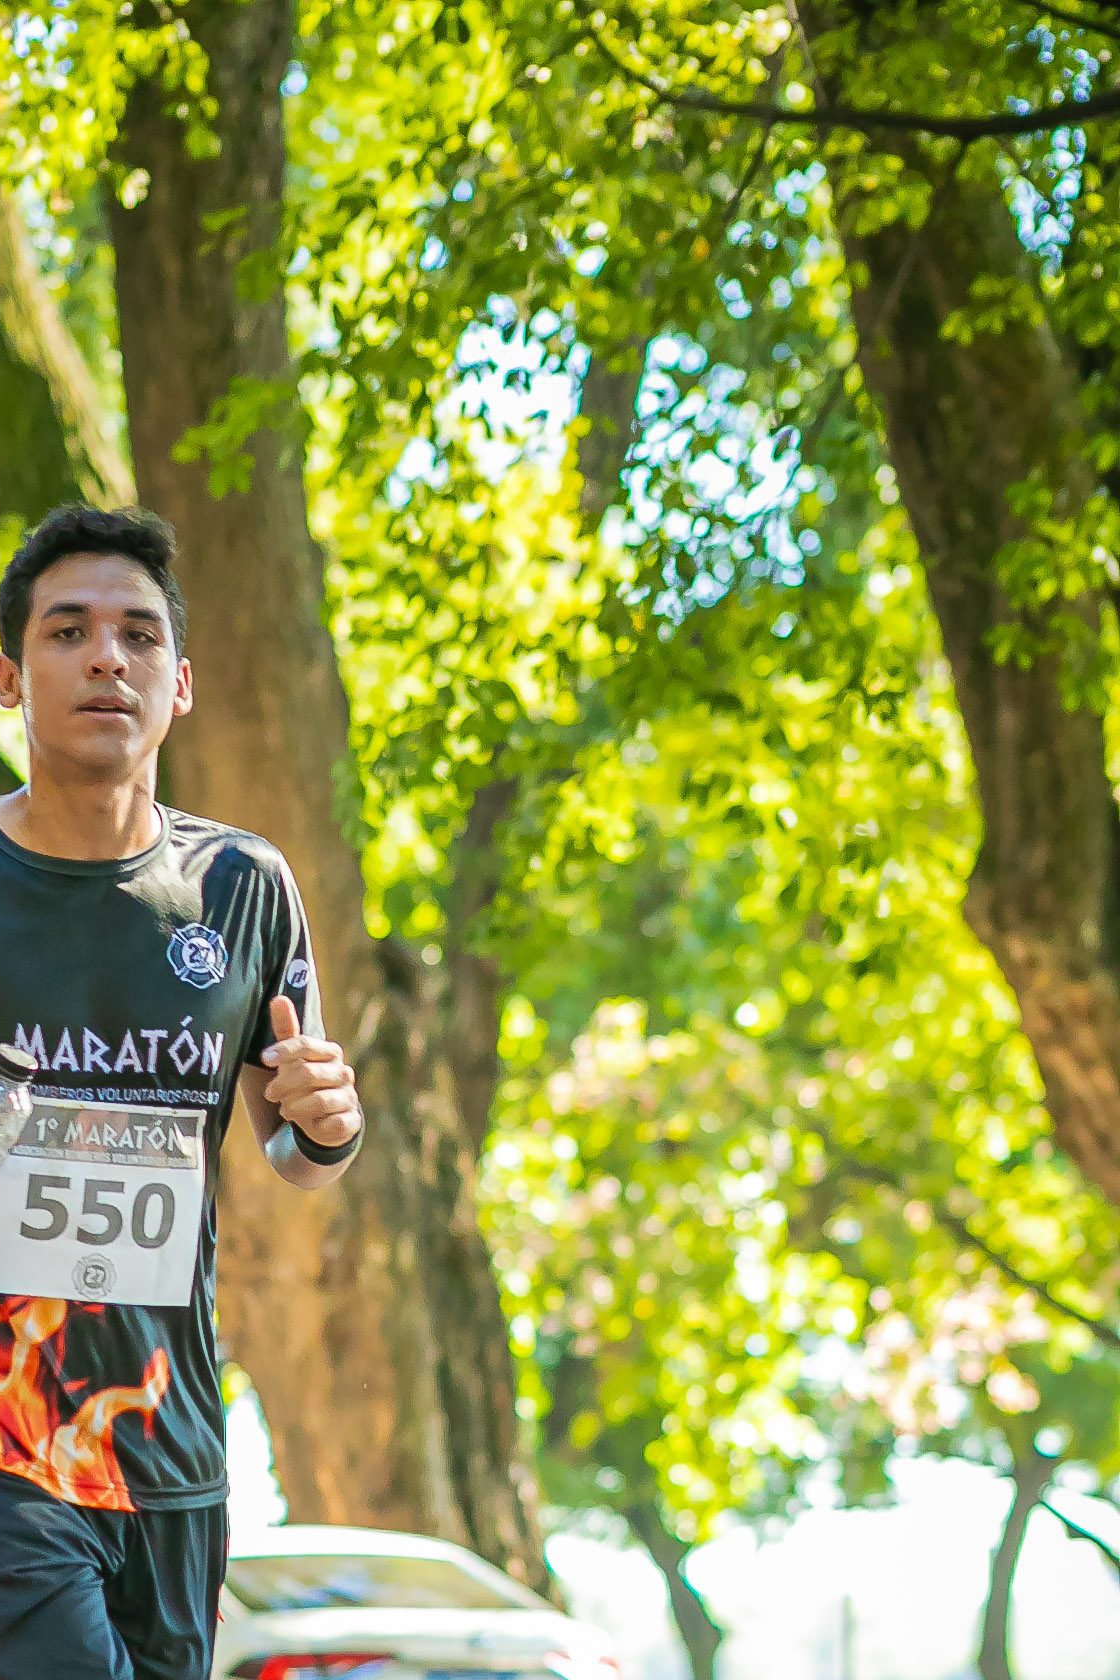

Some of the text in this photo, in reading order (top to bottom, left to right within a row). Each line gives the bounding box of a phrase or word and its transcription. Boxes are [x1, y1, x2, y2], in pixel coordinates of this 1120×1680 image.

[14, 1015, 225, 1076] MARATÓN
[28, 1084, 95, 1102] OMBEROS
[63, 1119, 182, 1152] MARATÓN
[20, 1172, 175, 1249] 550
